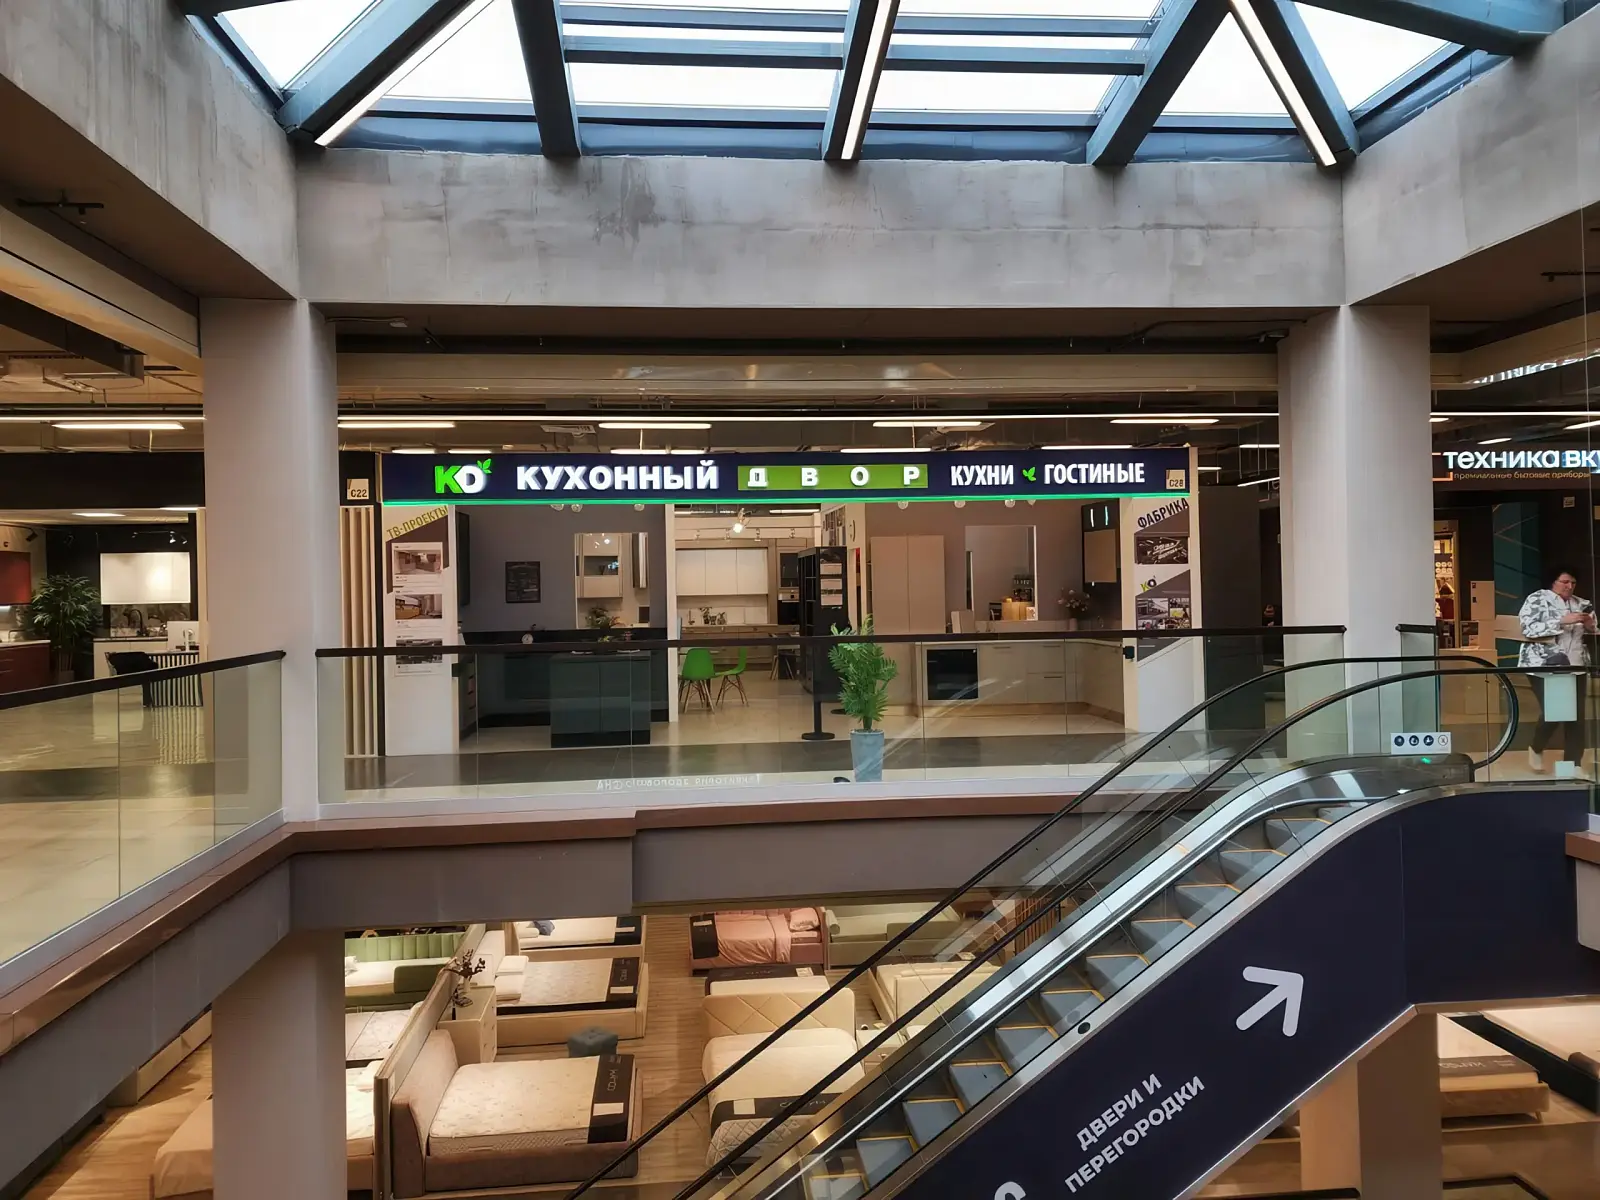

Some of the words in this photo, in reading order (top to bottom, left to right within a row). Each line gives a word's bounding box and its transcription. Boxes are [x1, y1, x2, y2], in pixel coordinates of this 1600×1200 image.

[1442, 450, 1560, 469] техника
[516, 460, 719, 491] КУХОННЫЙ
[950, 464, 1014, 487] КУХНИ
[1043, 462, 1146, 485] ГОСТИНЫЕ
[1138, 498, 1189, 528] ФАБРИКА
[1076, 1088, 1144, 1152] ДВЕРИ
[1141, 1074, 1163, 1095] И
[1065, 1076, 1205, 1194] ПЕРЕГОРОДКИ
